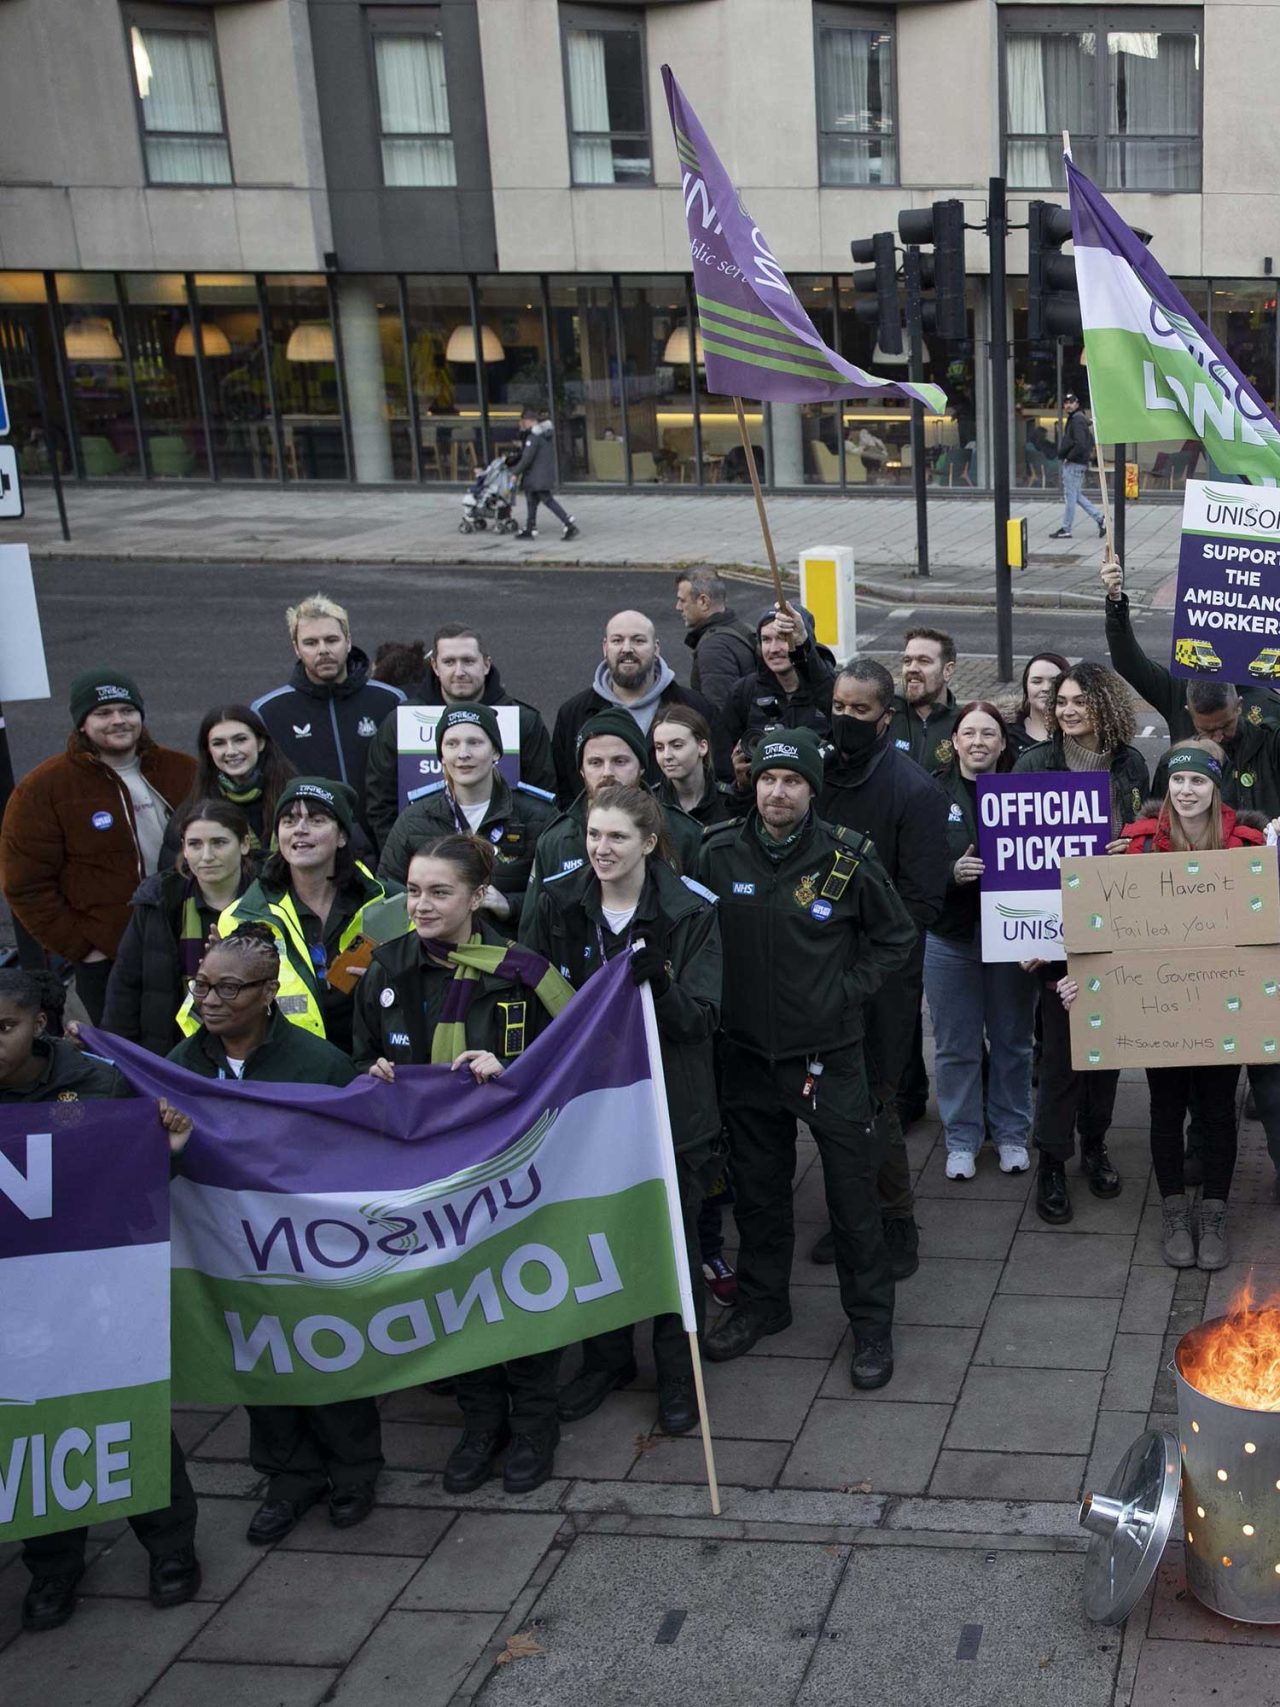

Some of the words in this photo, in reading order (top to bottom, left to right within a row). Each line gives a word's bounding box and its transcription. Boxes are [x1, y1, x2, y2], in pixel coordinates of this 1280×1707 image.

[1225, 569, 1261, 587] THE
[980, 790, 1108, 828] OFFICIAL
[562, 859, 584, 871] NHS
[996, 834, 1098, 871] PICKET
[733, 883, 753, 894] NHS
[1097, 869, 1141, 902] We
[1160, 870, 1235, 897] Haven't
[1003, 919, 1064, 941] UNIS
[1111, 914, 1170, 942] Failed
[1105, 965, 1143, 986] The
[1157, 963, 1247, 985] Government
[0, 1420, 133, 1523] VICE
